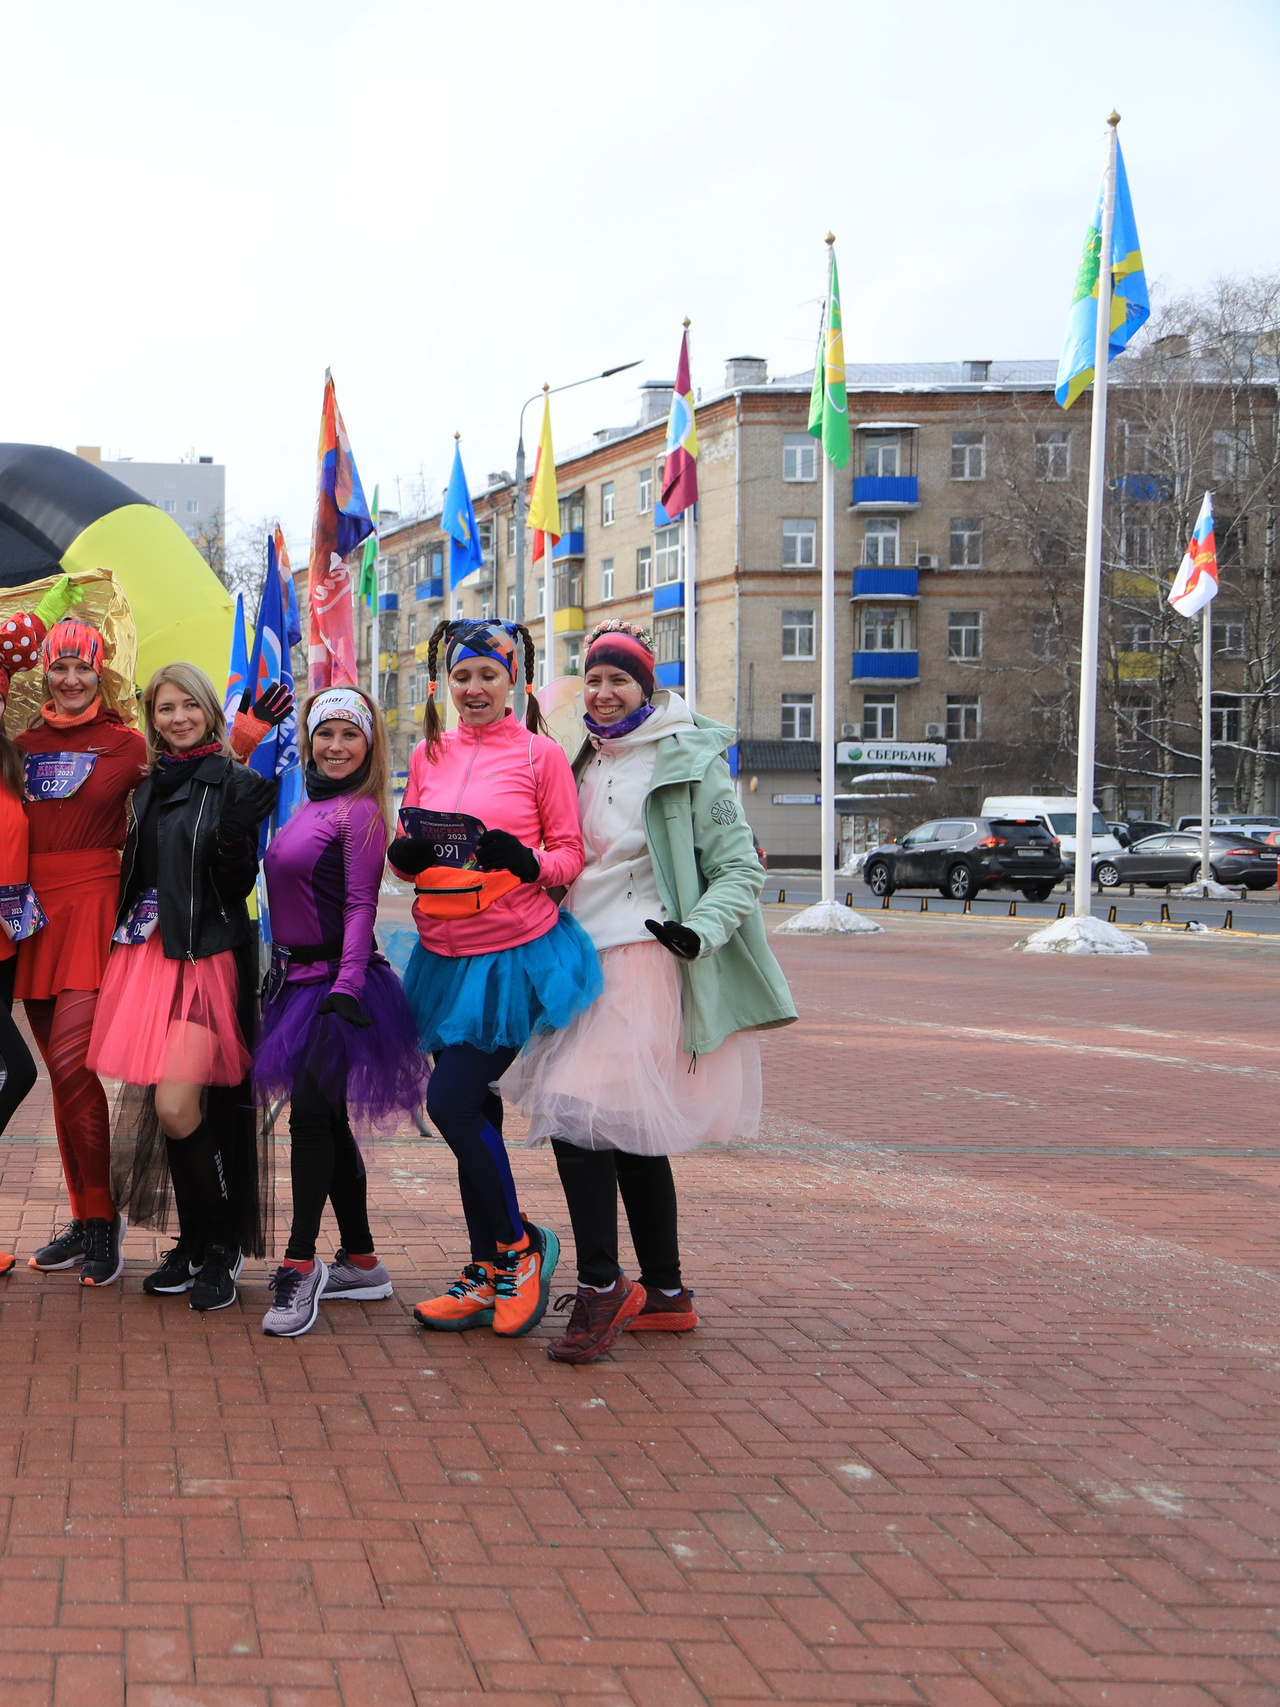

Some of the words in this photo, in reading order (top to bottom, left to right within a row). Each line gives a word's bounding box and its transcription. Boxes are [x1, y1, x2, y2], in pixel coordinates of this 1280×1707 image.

[867, 749, 937, 762] СБЕРБАНК
[41, 779, 69, 792] 027
[447, 833, 467, 841] 2023
[433, 844, 459, 860] 091
[11, 907, 23, 915] 2023
[5, 919, 22, 932] 18
